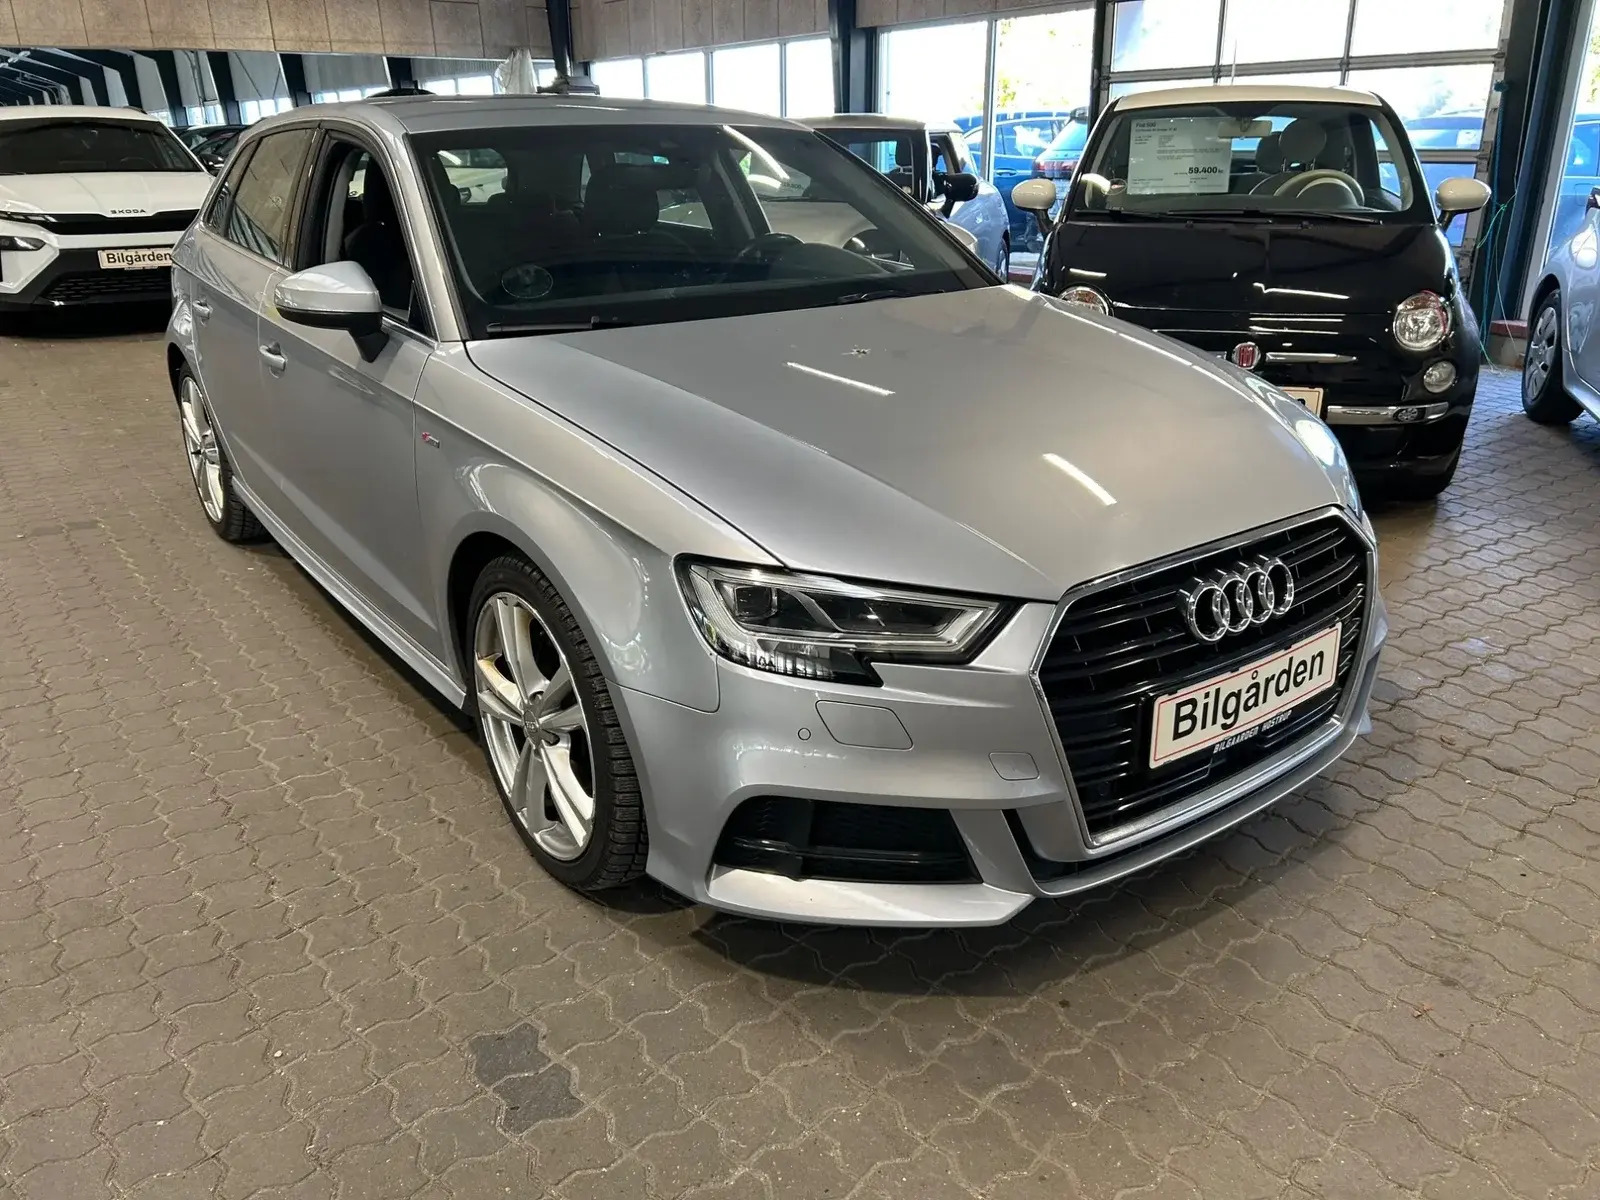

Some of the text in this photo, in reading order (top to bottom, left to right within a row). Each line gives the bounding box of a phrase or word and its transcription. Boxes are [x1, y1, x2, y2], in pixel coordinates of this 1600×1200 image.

[1188, 166, 1218, 174] 59.400
[106, 250, 172, 265] Bilgården
[1172, 650, 1325, 741] Bilgården
[1213, 726, 1259, 754] BILGAARDEN
